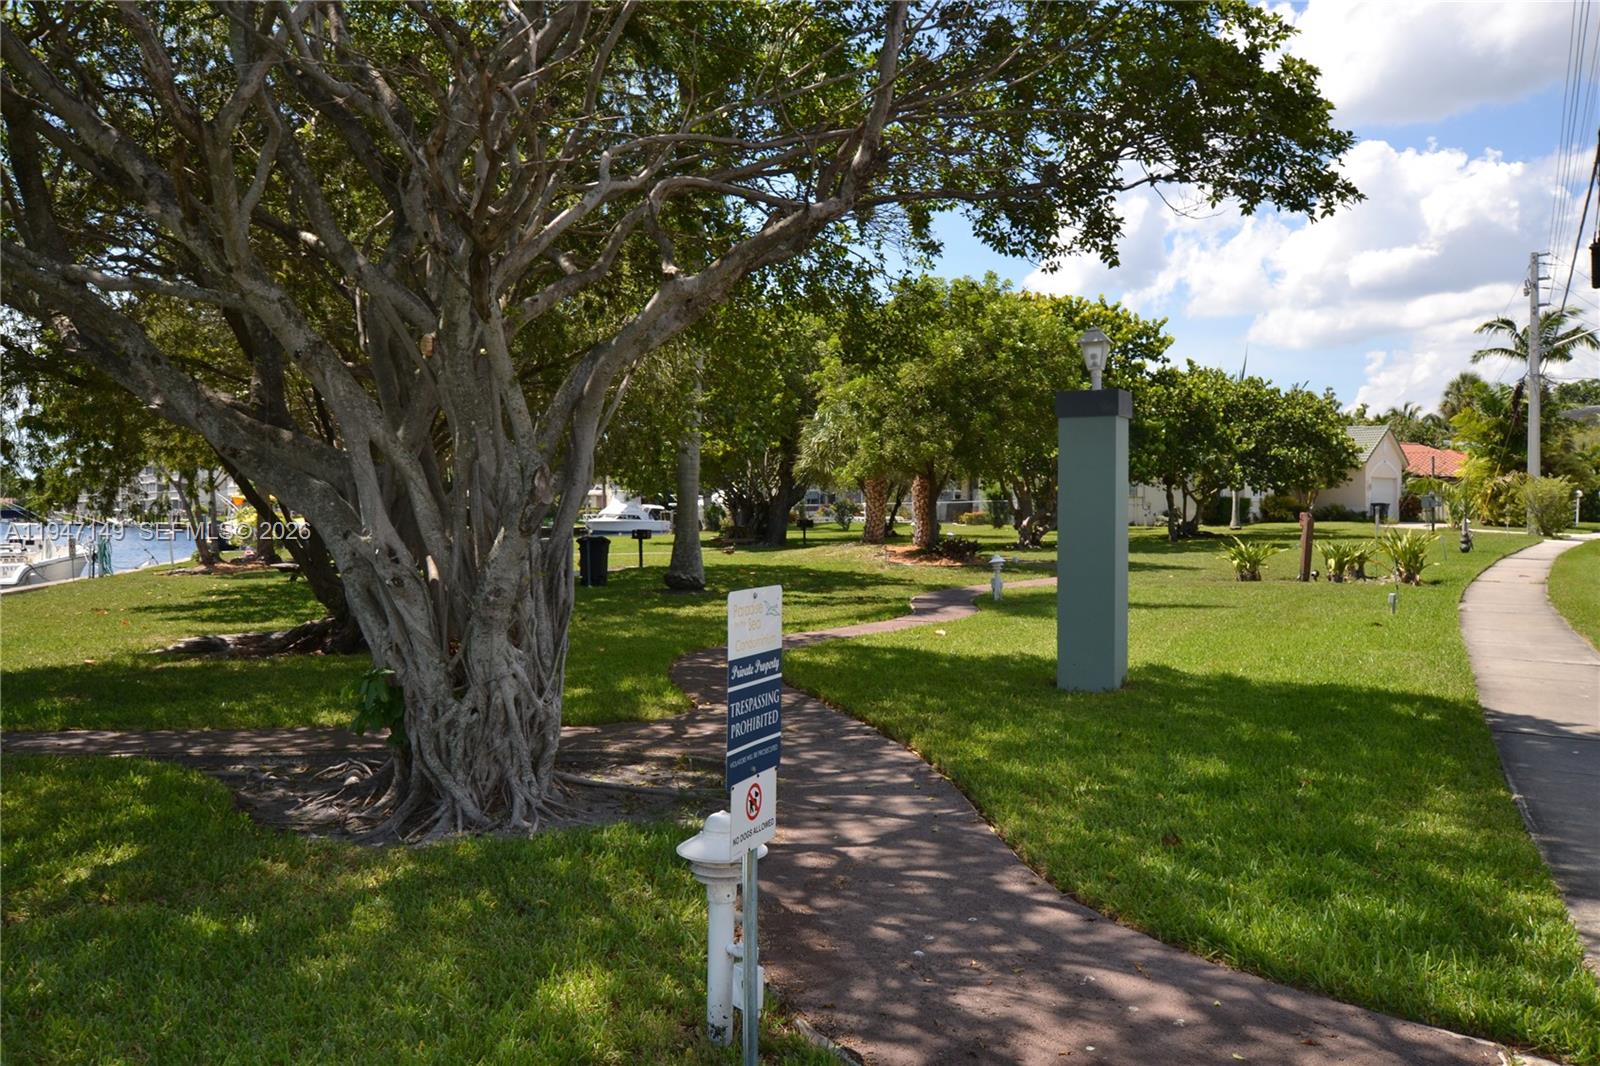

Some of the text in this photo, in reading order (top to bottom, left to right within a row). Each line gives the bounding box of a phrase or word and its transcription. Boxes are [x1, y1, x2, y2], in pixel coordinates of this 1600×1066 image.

[731, 656, 780, 680] Private Property
[730, 689, 780, 718] TRESPASSING
[731, 709, 779, 739] PROHIBITED
[732, 817, 775, 846] NO DOGS ALLOWED
